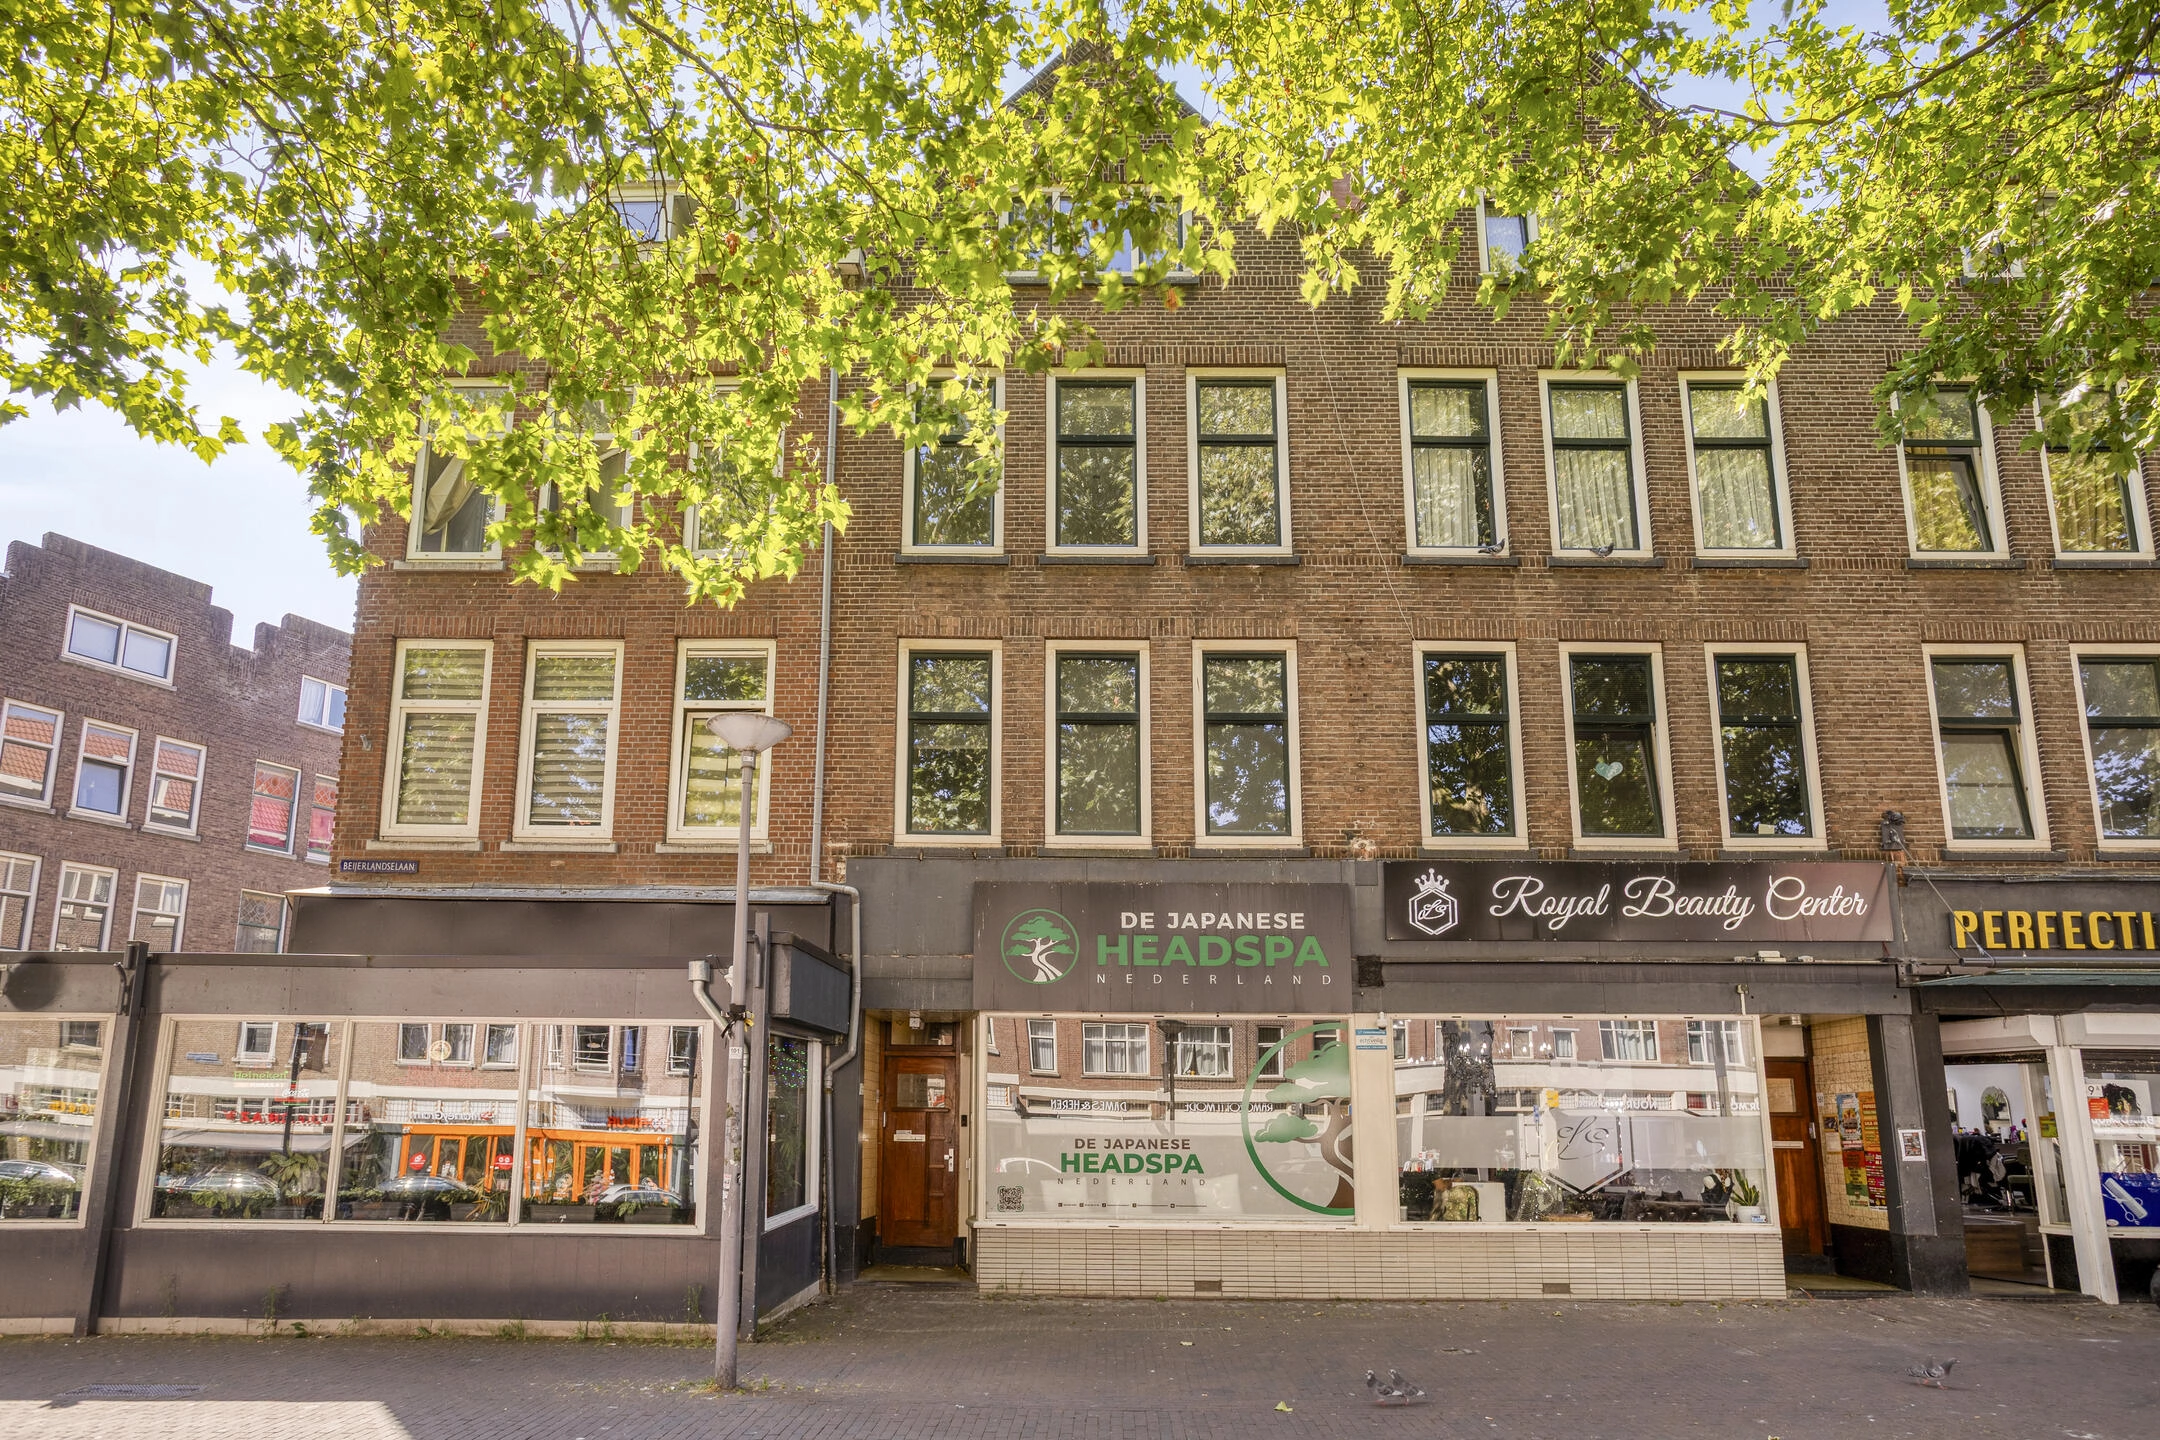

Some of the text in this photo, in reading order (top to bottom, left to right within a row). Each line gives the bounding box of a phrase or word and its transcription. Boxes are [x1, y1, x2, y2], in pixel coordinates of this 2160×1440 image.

[343, 861, 415, 872] BEIJERLANDSELAAN
[1489, 874, 1868, 930] Royal Beauty Center
[1121, 912, 1305, 930] DE JAPANESE
[1953, 910, 2156, 950] PERFECTI
[1097, 935, 1330, 967] HEADSPA
[1096, 974, 1332, 985] NEDERLAND
[1075, 1138, 1191, 1150] DE JAPANESE
[1060, 1153, 1204, 1174] HEADSPA
[1057, 1177, 1206, 1186] NEDERLAND
